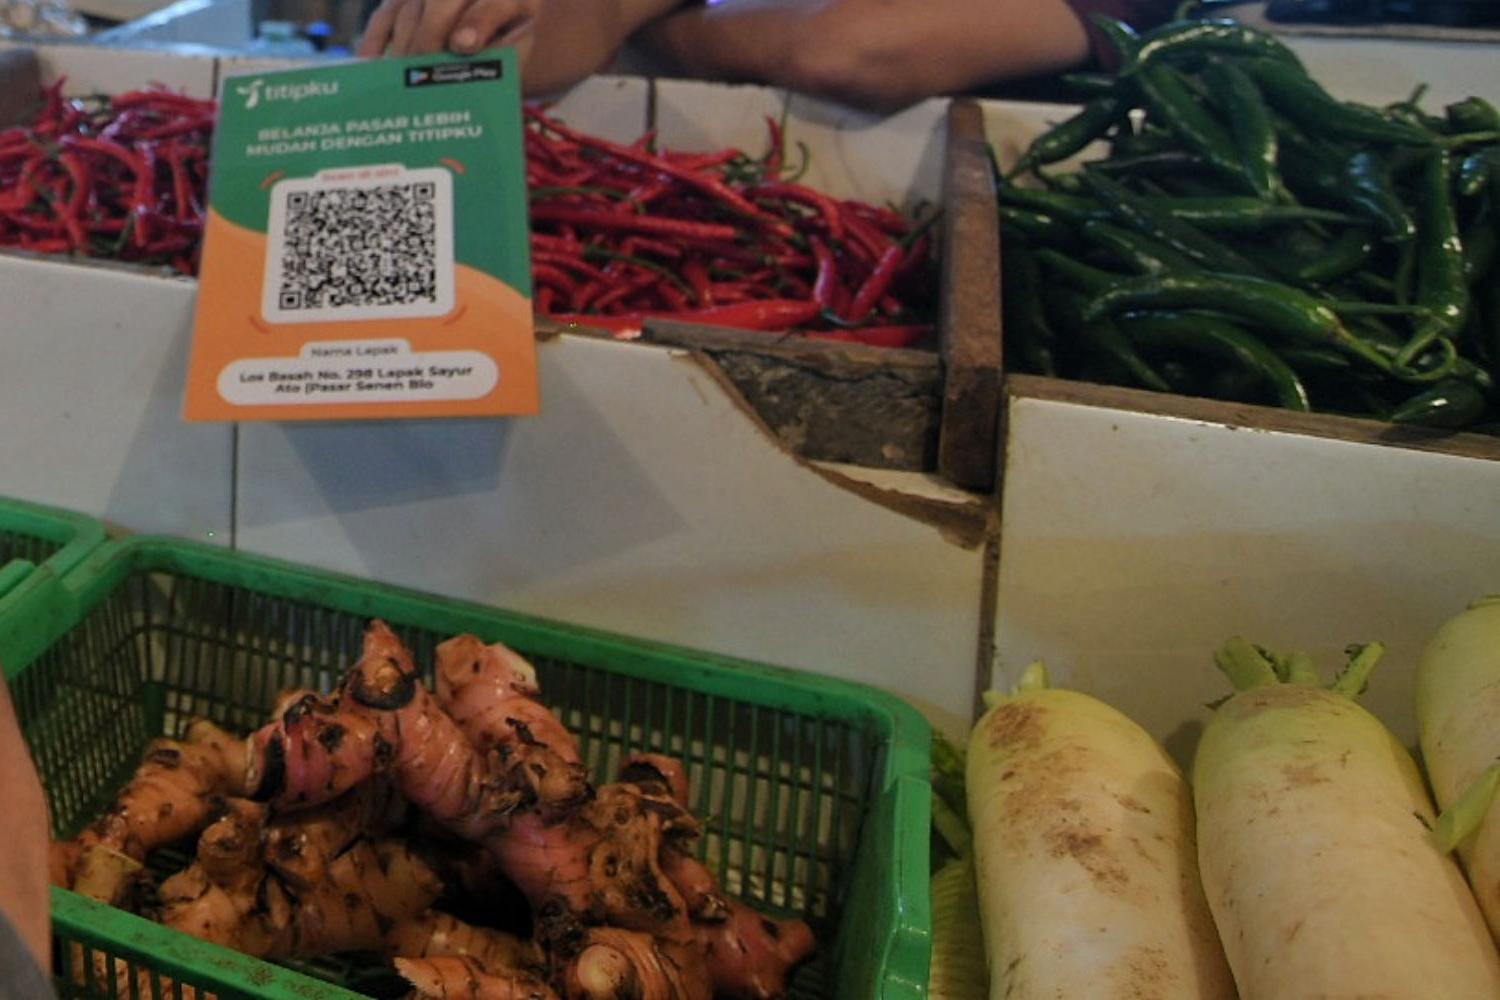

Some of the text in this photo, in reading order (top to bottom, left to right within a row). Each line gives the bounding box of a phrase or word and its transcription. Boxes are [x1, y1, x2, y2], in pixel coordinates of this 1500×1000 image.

[265, 79, 339, 101] titipku
[258, 111, 471, 142] BELANJA PASAR LEBIH
[247, 125, 483, 156] MUDAH DENGAN TITIPKU
[311, 345, 398, 358] Nama Lapak
[239, 365, 474, 383] Los Basah No. 298 Lapak Sayur
[356, 380, 404, 391] Senen
